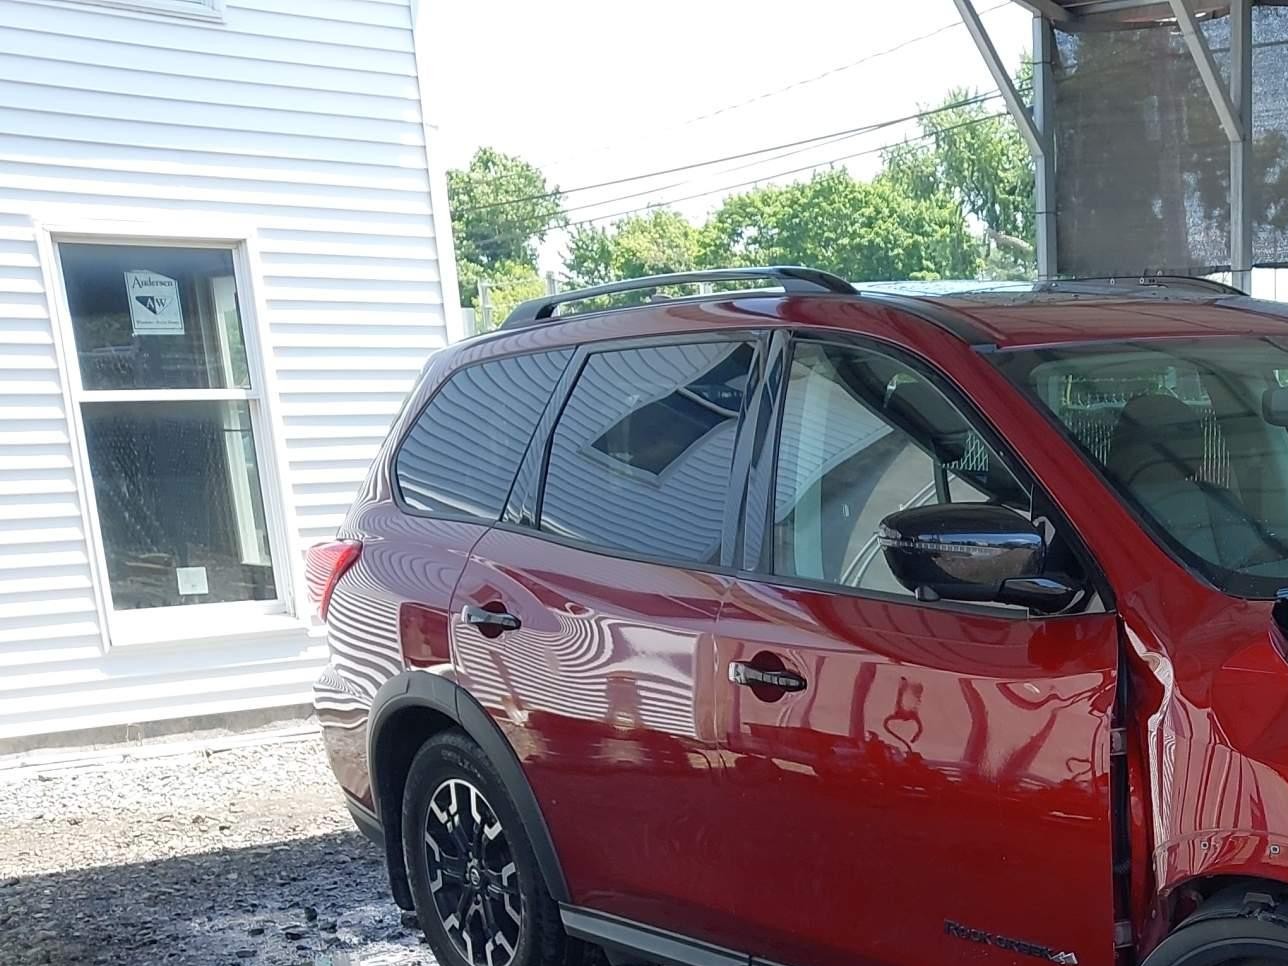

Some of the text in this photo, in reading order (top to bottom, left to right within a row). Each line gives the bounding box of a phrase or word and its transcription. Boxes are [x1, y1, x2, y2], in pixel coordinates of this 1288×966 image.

[132, 275, 173, 289] Andersen
[146, 297, 167, 308] AW
[943, 918, 1053, 961] ROCK CREEK
